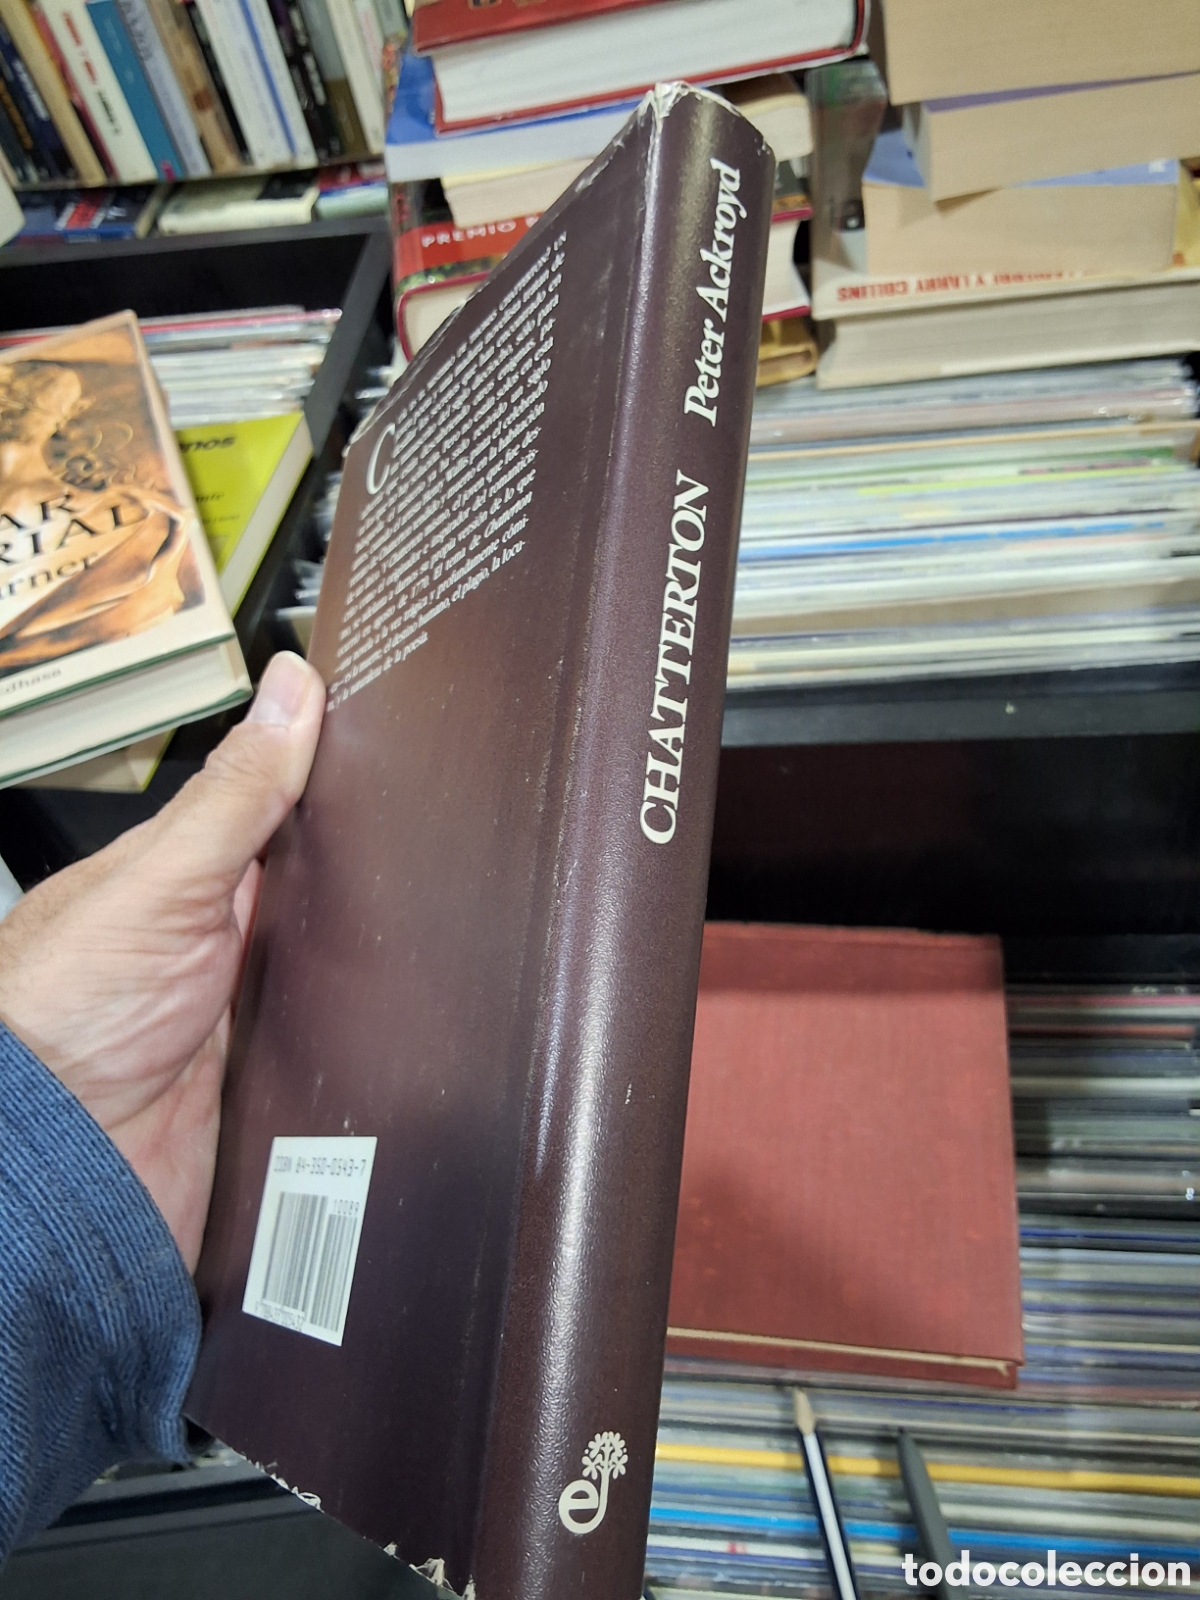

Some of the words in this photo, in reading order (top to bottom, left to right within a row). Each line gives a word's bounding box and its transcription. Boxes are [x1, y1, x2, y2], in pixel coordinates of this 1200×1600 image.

[421, 219, 517, 248] PREMIO
[695, 157, 748, 322] Ackroyd
[684, 318, 725, 427] Peter
[436, 538, 500, 600] profundamente
[502, 514, 528, 543] cómi-
[445, 547, 466, 570] tema
[484, 491, 532, 538] Chatterton
[457, 511, 488, 541] versión
[460, 567, 490, 599] plagio,
[501, 540, 525, 564] locu-
[639, 469, 709, 844] CHATTERTON
